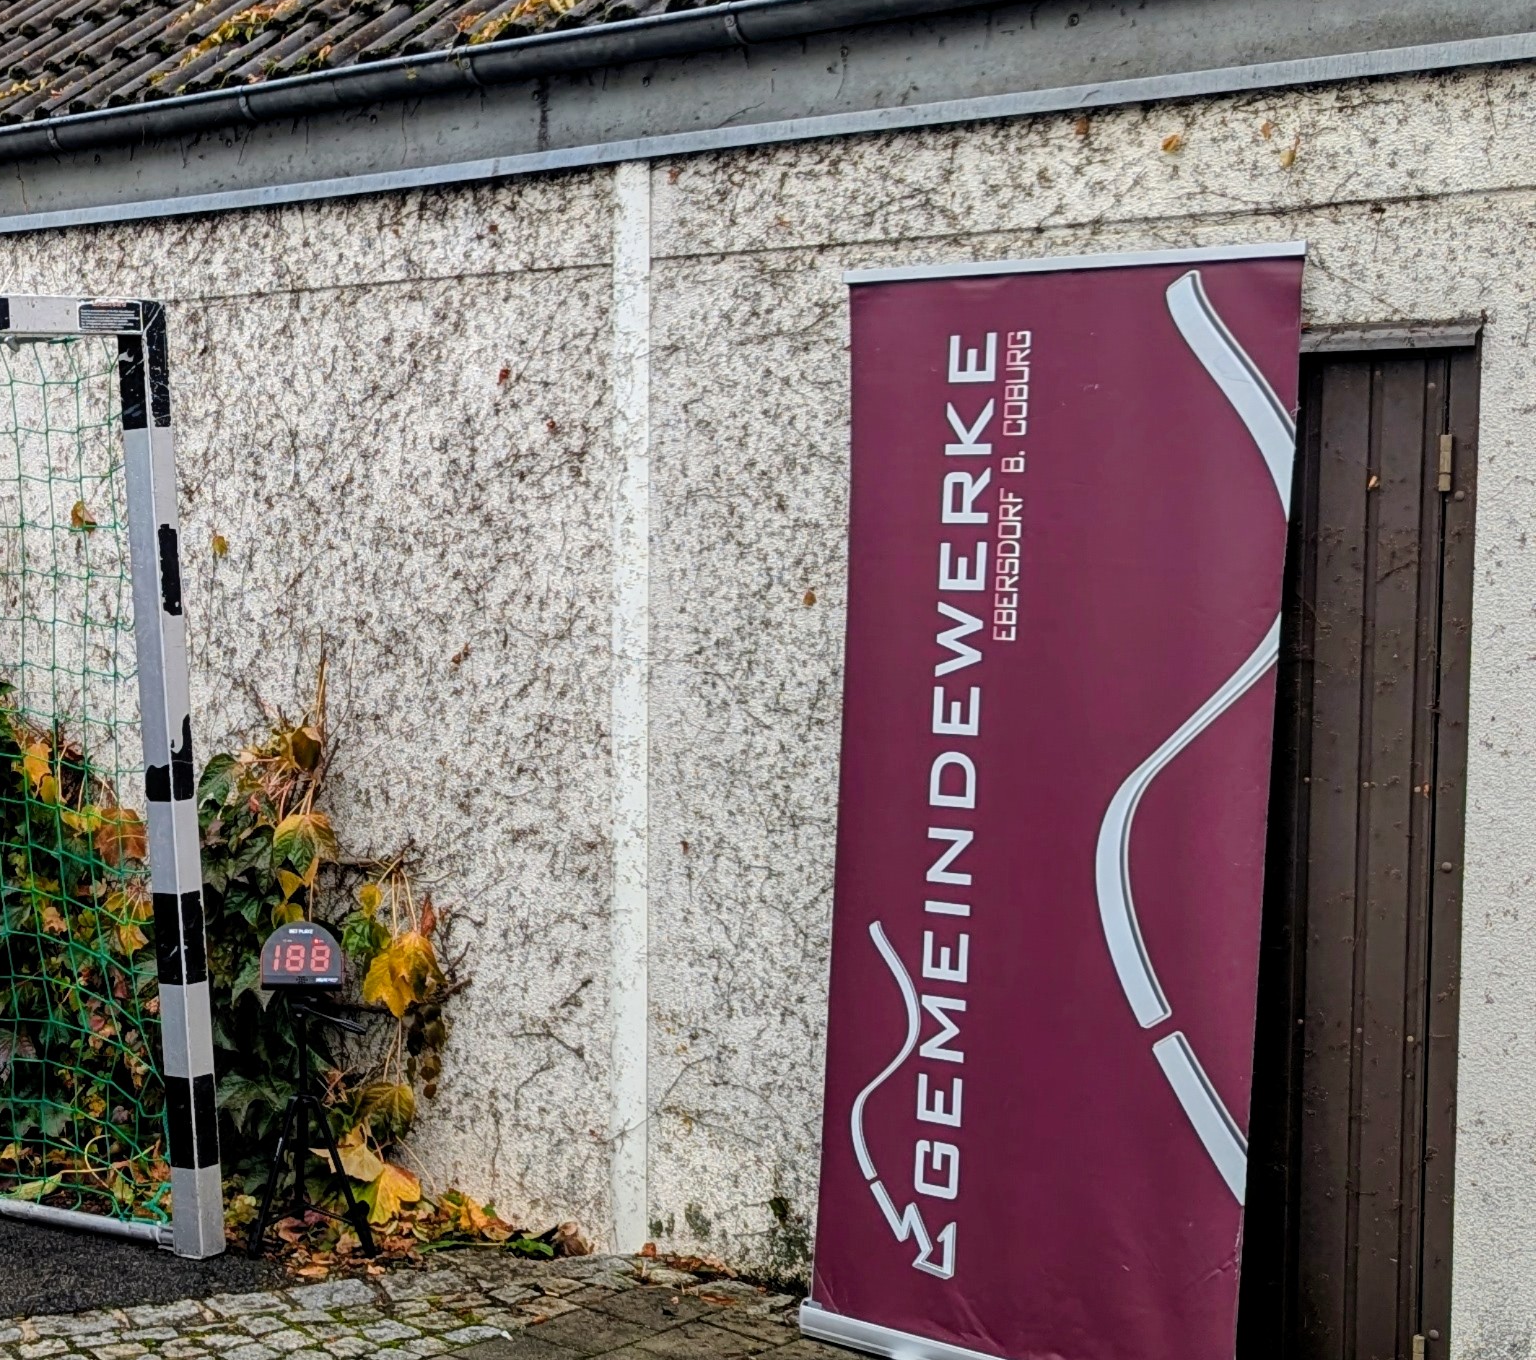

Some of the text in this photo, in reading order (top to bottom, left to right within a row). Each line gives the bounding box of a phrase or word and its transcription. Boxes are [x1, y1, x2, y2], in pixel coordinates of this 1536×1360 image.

[992, 330, 1032, 642] EBERSDORF B. COBURG
[914, 332, 998, 1200] GEMEINDEWERKE
[273, 944, 331, 972] 188
